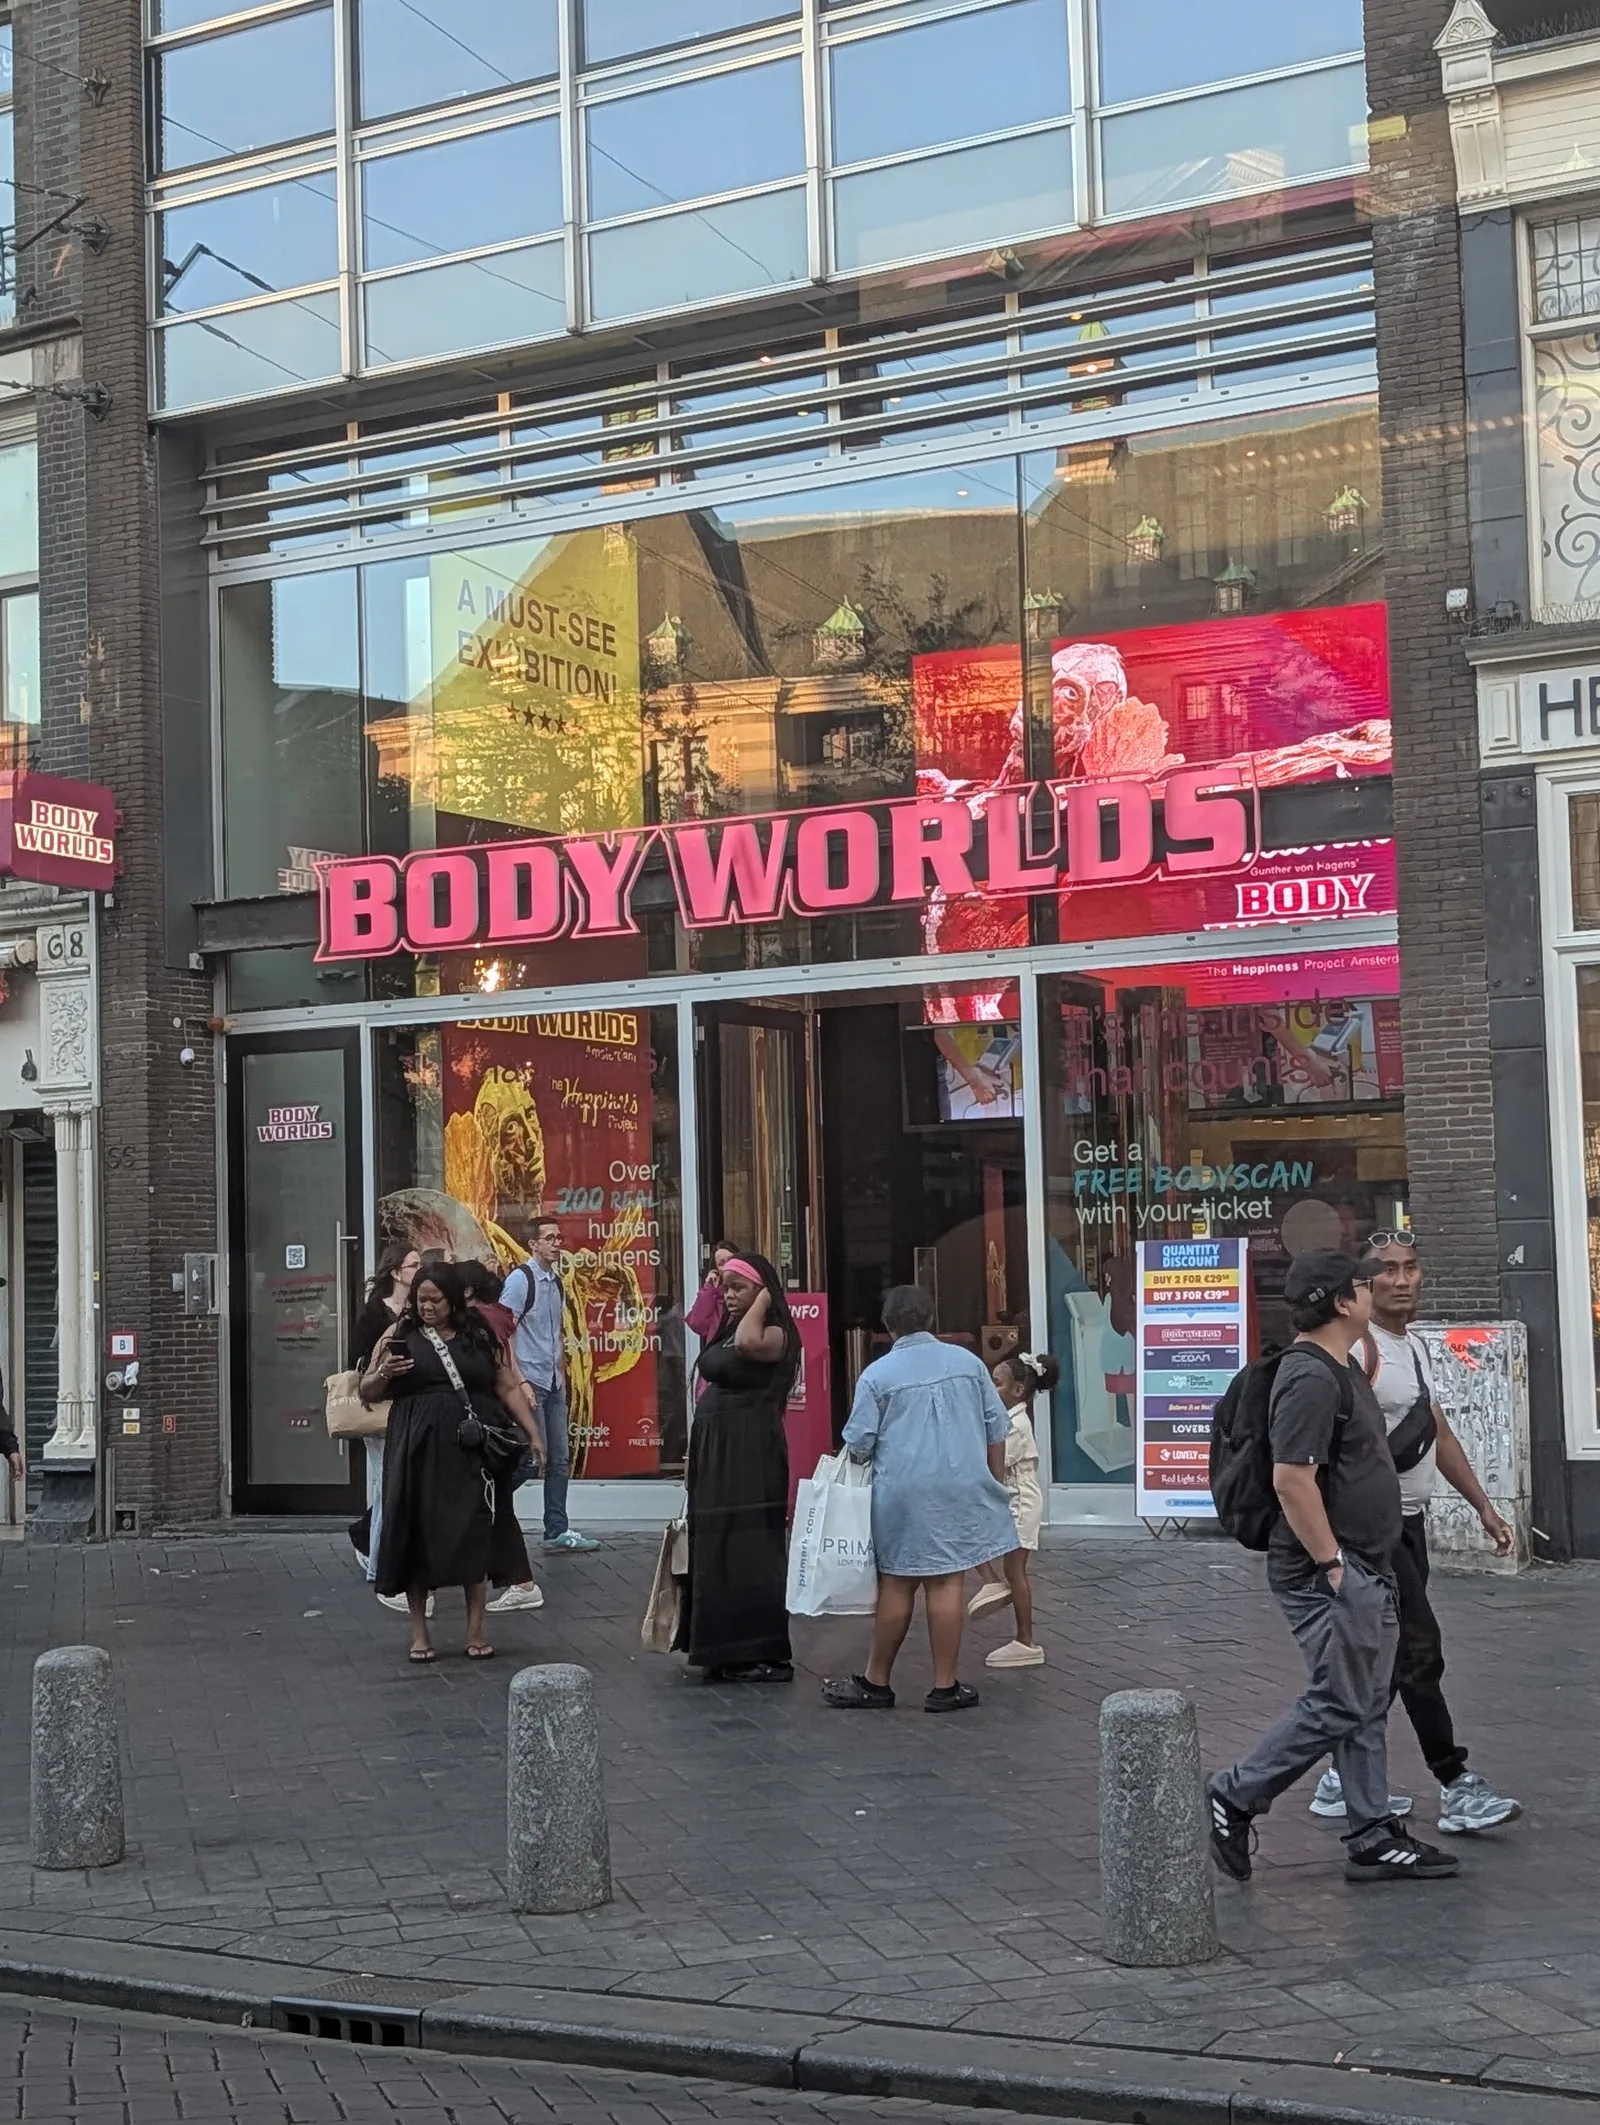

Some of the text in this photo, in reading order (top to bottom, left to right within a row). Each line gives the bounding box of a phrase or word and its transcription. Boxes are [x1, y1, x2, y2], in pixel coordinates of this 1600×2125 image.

[458, 579, 618, 657] A MUST-SEE
[31, 800, 99, 835] BODY
[15, 823, 113, 864] WORLDS
[315, 758, 1258, 960] BODY WORLDS
[1250, 865, 1291, 877] Gunther
[1294, 863, 1313, 873] von
[1235, 873, 1376, 919] BODY
[48, 931, 83, 960] 68
[1233, 961, 1298, 977] Happiness
[1304, 956, 1345, 971] Project
[268, 1105, 320, 1124] BODY
[257, 1122, 332, 1142] WORLDS
[1074, 1139, 1142, 1163] Get a
[609, 1160, 659, 1182] Over
[1073, 1161, 1313, 1198] FREE BODYSCAN
[556, 1186, 604, 1214] 200
[1076, 1195, 1273, 1229] with your ticket
[588, 1218, 660, 1239] human
[560, 1246, 660, 1273] pecimens
[1162, 1244, 1220, 1257] QUANTITY
[1162, 1256, 1220, 1268] DISCOUNT
[1153, 1275, 1172, 1285] BUY
[1174, 1275, 1181, 1284] 2
[1183, 1274, 1201, 1284] FOR
[1153, 1291, 1172, 1301] BUY
[1174, 1291, 1181, 1301] 3
[1183, 1291, 1202, 1300] FOR
[593, 1302, 662, 1323] 7-floor
[788, 1305, 819, 1320] NFO
[120, 1339, 126, 1351] B
[568, 1422, 610, 1439] Google
[1172, 1424, 1211, 1433] LOVERS
[1172, 1450, 1198, 1459] LOVELY
[1161, 1474, 1176, 1483] Red
[1177, 1474, 1195, 1485] Light
[799, 1507, 816, 1588] primark.com
[823, 1538, 874, 1556] PRIM
